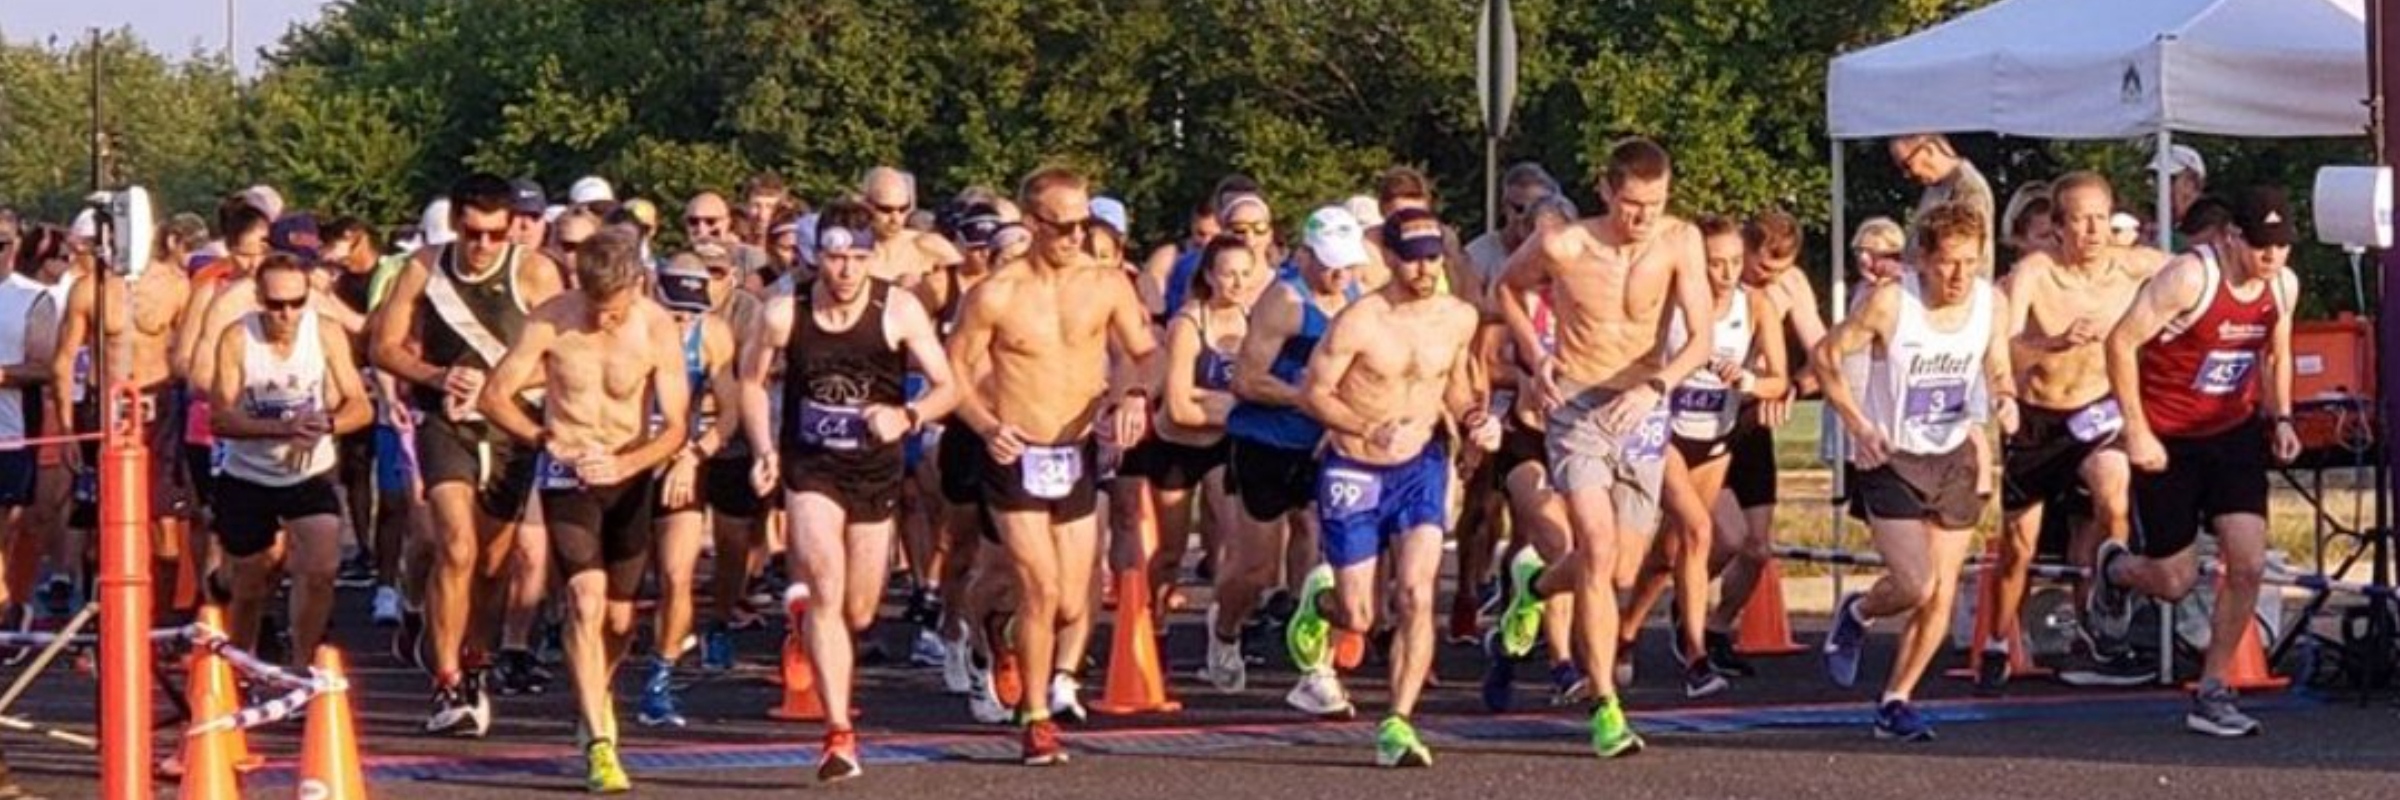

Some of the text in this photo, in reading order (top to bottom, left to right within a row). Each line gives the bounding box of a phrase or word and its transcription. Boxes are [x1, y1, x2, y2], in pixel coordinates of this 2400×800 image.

[1930, 389, 1945, 412] 3
[817, 417, 848, 436] 64
[1331, 481, 1361, 507] 99
